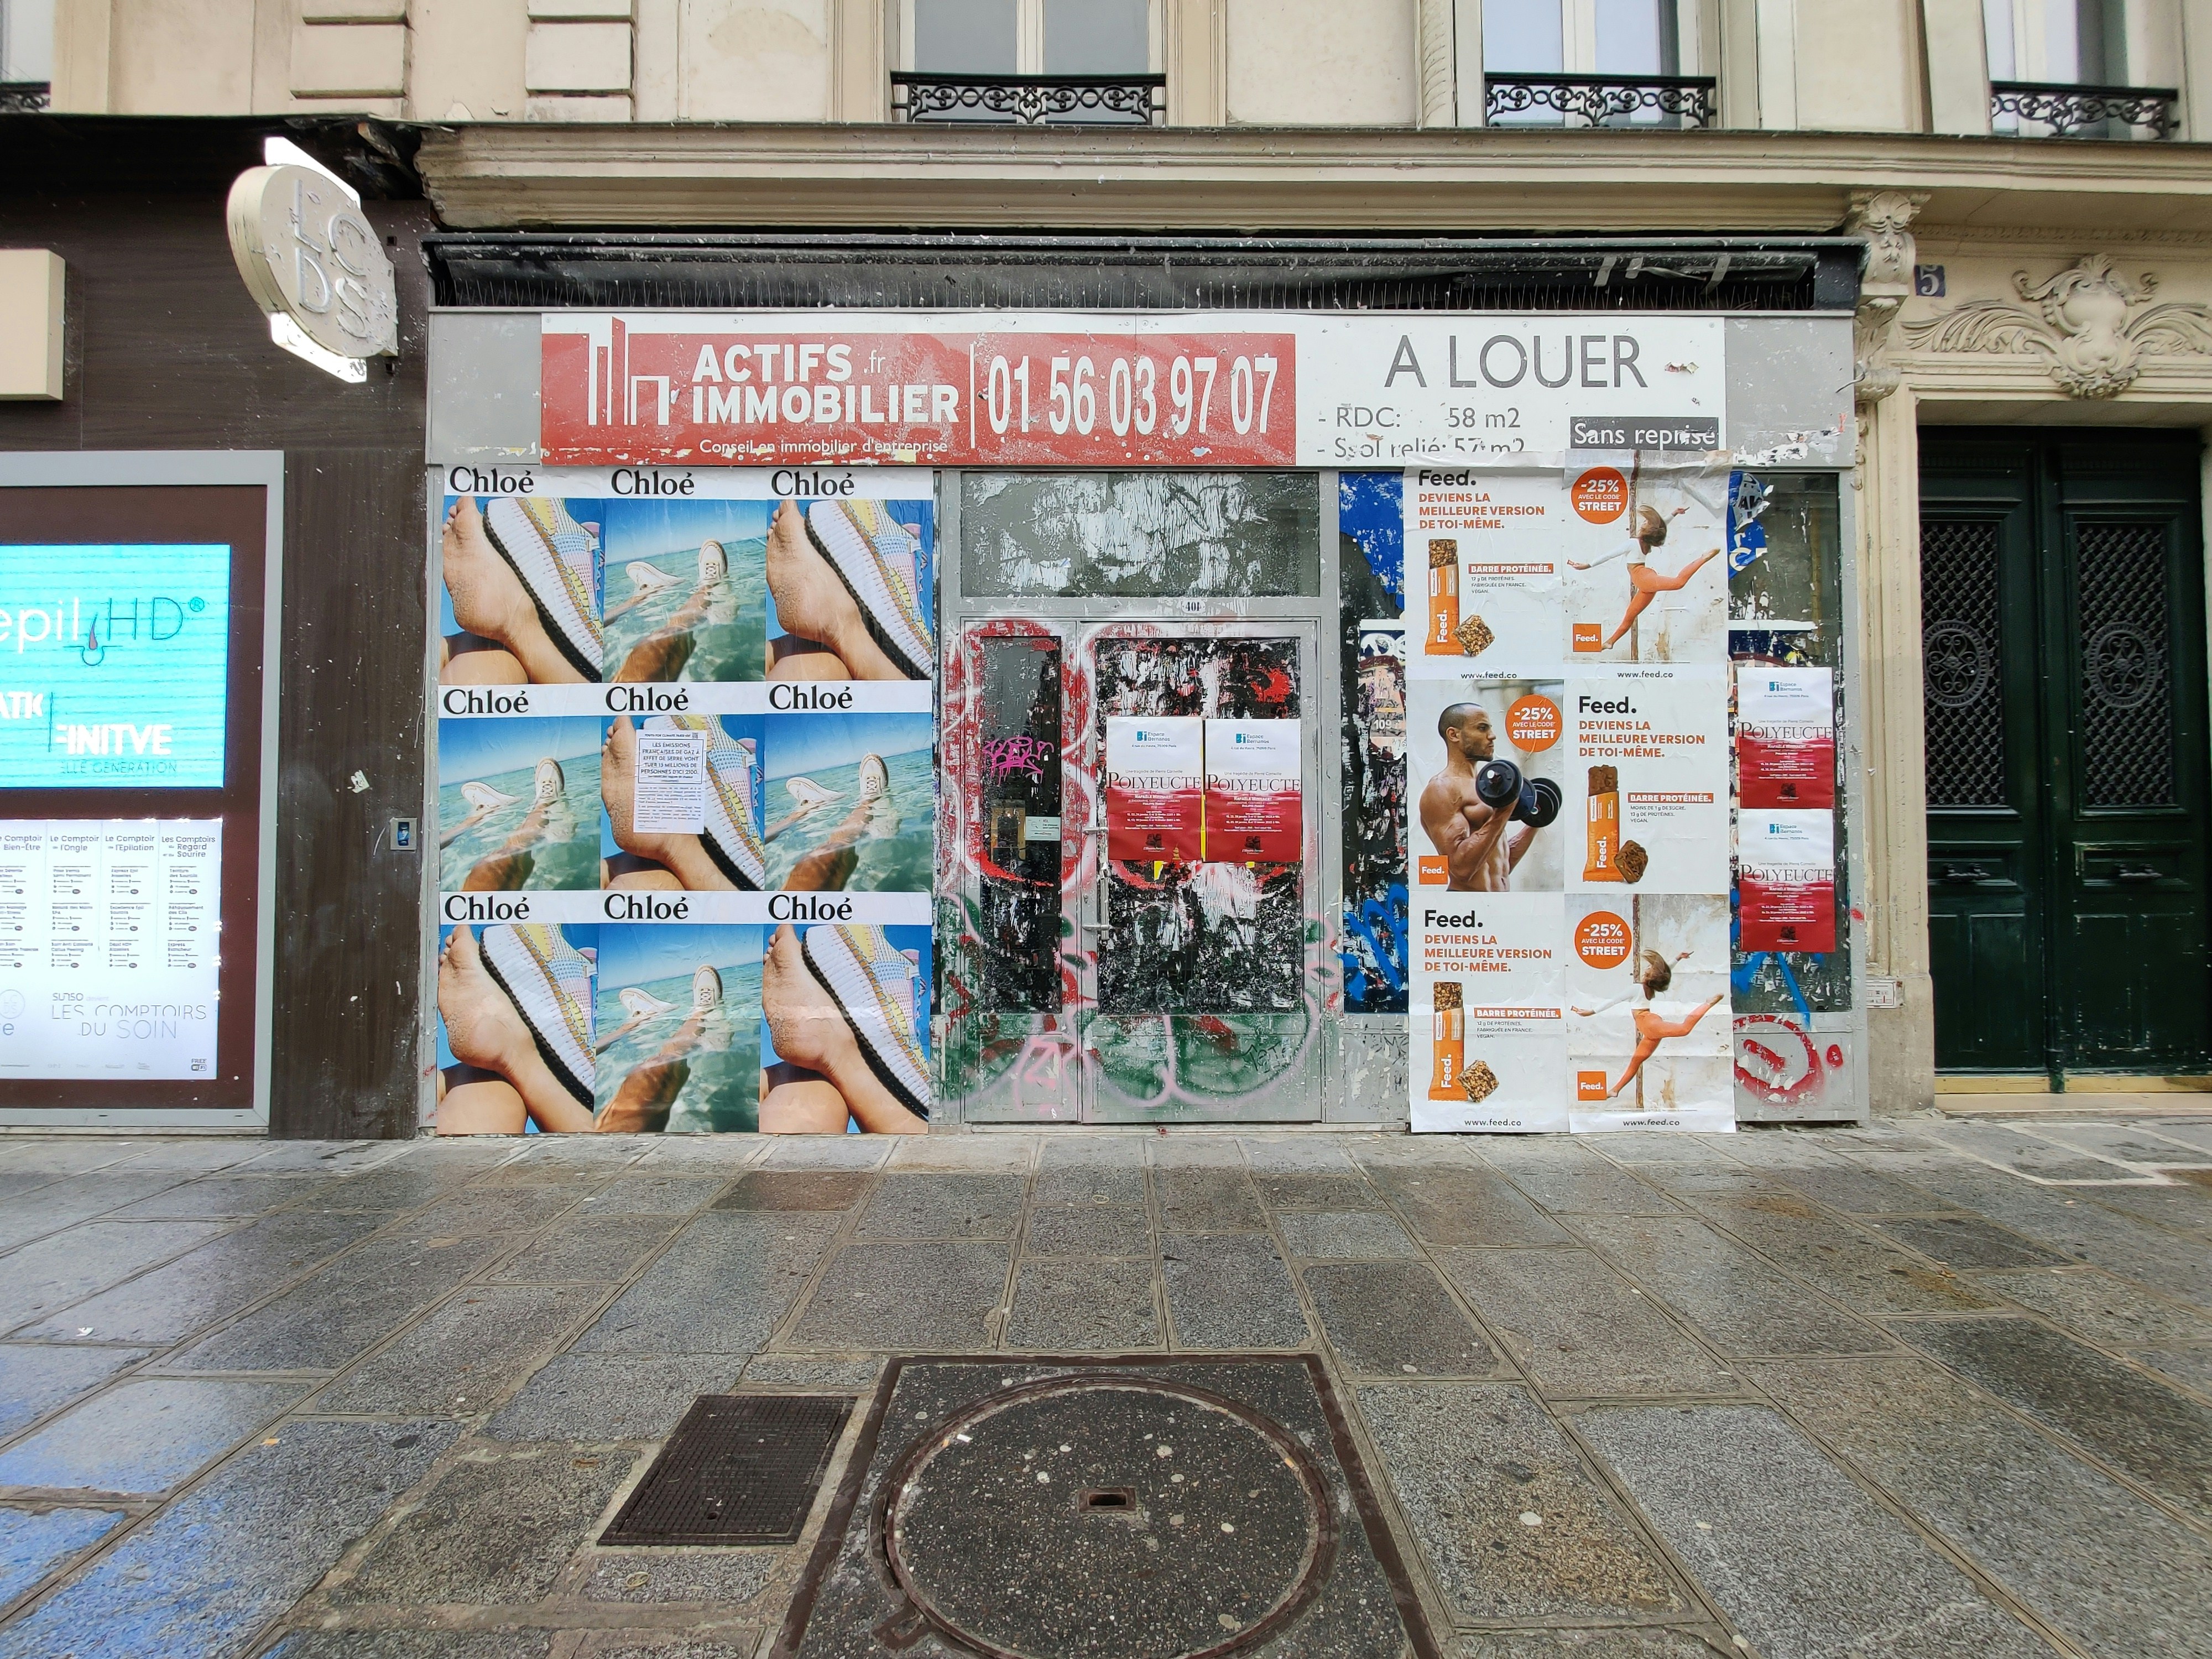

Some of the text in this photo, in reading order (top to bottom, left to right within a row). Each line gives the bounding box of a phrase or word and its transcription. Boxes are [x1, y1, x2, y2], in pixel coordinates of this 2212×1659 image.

[1919, 265, 1939, 295] 5
[692, 344, 853, 383] ACTIFS
[1384, 335, 1648, 389] A LOUER
[988, 354, 1277, 436] 01 56 03 97 07
[692, 384, 959, 424] IMMOBILIER
[1337, 407, 1521, 428] RDC: 58 m2
[1575, 422, 1716, 451] Sans reprise
[700, 439, 754, 453] Conseil
[781, 439, 855, 453] immobilier
[862, 440, 948, 455] d'entreprise
[449, 467, 534, 494] Chloé
[611, 468, 695, 495] Chloé
[771, 468, 855, 497] Chloé
[1419, 469, 1476, 486] Feed.
[1581, 479, 1620, 493] -25%
[1419, 493, 1490, 503] DEVIENS LA
[1419, 506, 1545, 517] MEILLEURE VERSION
[1578, 502, 1622, 512] STREET
[1419, 517, 1505, 529] DE TOI-MÊME.
[1501, 564, 1552, 573] PROTÉINÉE.
[1437, 609, 1448, 643] Feed.
[1575, 634, 1599, 643] Feed.
[1461, 671, 1517, 680] www.feed.co
[1617, 671, 1674, 679] www.feed.co
[444, 688, 529, 714] Chloé
[606, 686, 689, 712] Chloé
[769, 684, 853, 710] Chloé
[1579, 696, 1637, 714] Feed.
[1514, 707, 1553, 720] -25%
[1512, 729, 1556, 739] STREET
[1579, 720, 1651, 731] DEVIENS LA
[1740, 722, 1832, 739] POLYEUCTE
[1579, 734, 1705, 744] MEILLEURE VERSION
[1579, 745, 1665, 758] DE TOI-MÊME.
[1107, 771, 1201, 789] POLYEUCTE
[1206, 774, 1300, 791] POLYEUCTE
[1661, 793, 1712, 802] PROTÉINÉE.
[1597, 836, 1607, 868] Feed.
[1421, 866, 1445, 874] Feed.
[1740, 864, 1833, 882] POLYEUCTE
[445, 895, 530, 921] Chloé
[604, 894, 689, 921] Chloé
[768, 894, 853, 921] Chloé
[1425, 910, 1483, 927] Feed.
[1583, 924, 1623, 937] -25%
[1425, 935, 1497, 945] DEVIENS LA
[1425, 948, 1552, 959] MEILLEURE VERSION
[1582, 946, 1625, 956] STREET
[1425, 959, 1511, 972] DE TOI-MÊME.
[1507, 1008, 1559, 1018] PROTÉINÉE.
[82, 1020, 176, 1039] DU SOIN
[1441, 1053, 1452, 1088] Feed.
[1580, 1082, 1604, 1091] Feed.
[1464, 1118, 1521, 1126] www.feed.co
[1623, 1119, 1680, 1127] www.feed.co
